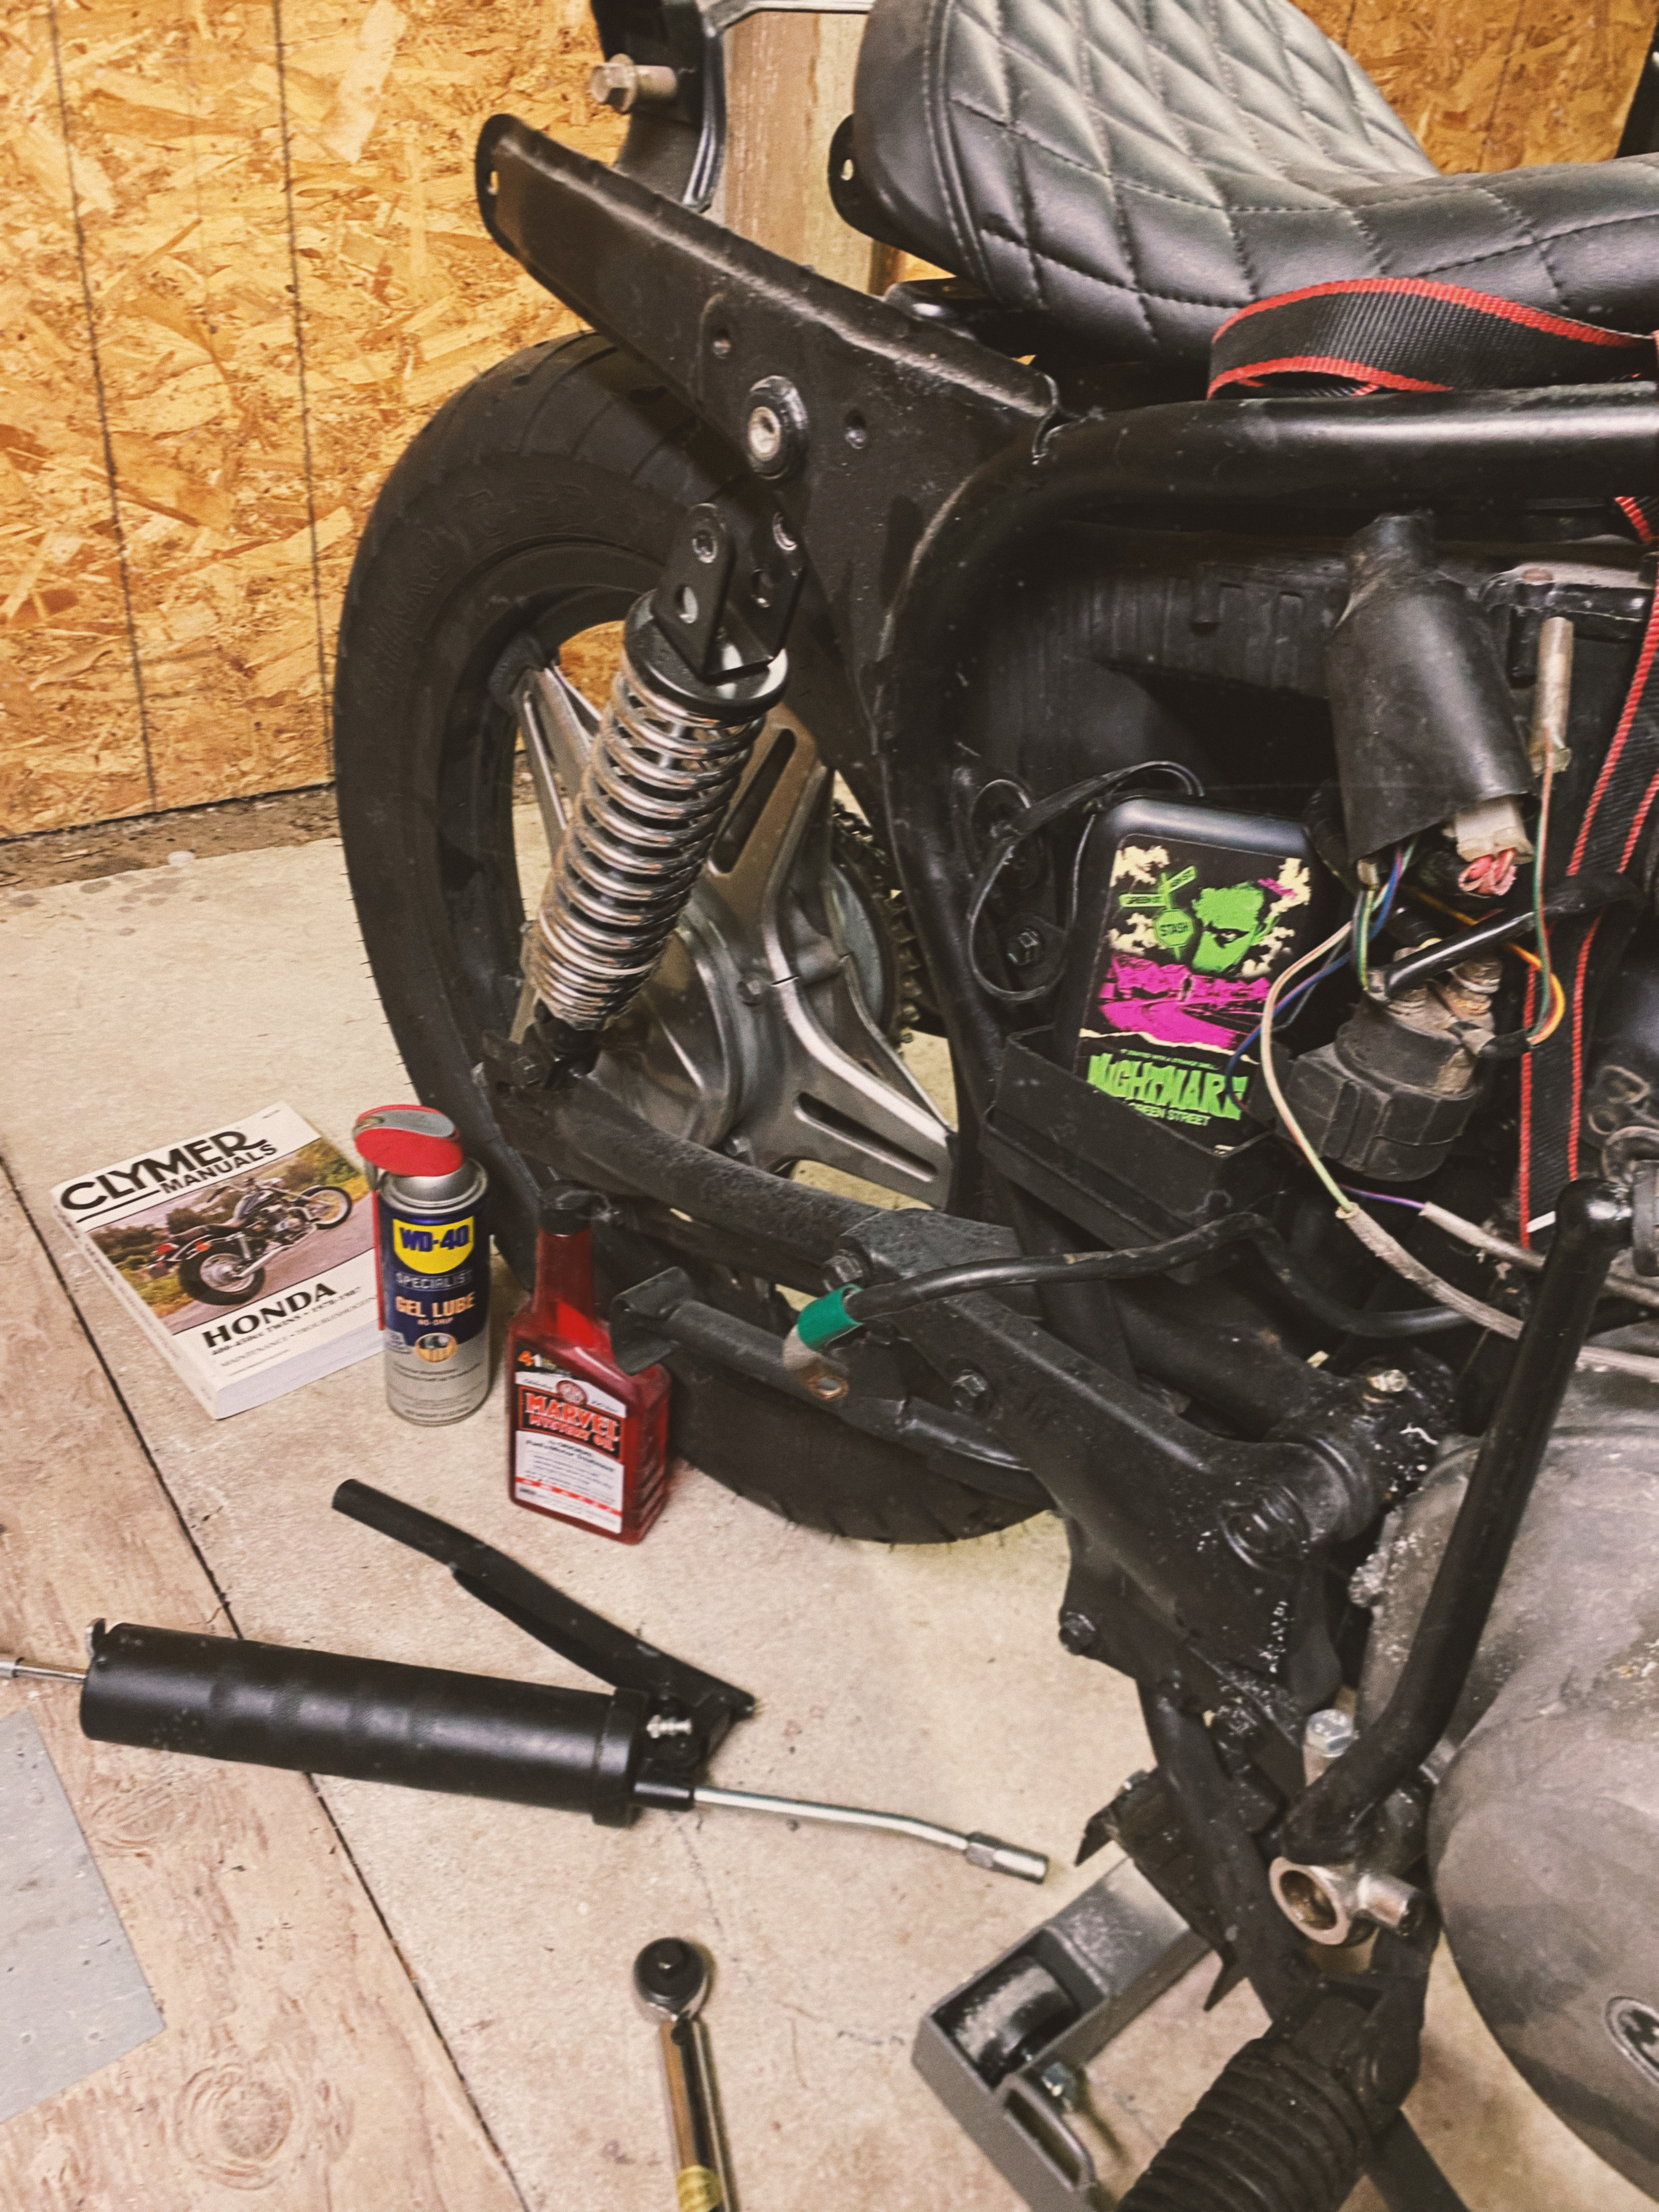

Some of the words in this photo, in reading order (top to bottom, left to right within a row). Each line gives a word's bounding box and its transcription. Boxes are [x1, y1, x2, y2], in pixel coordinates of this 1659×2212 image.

[1159, 921, 1189, 937] STASH
[1166, 1109, 1212, 1126] STREET
[60, 1130, 267, 1210] CLYMER
[160, 1144, 278, 1194] MANUALS
[399, 1224, 469, 1253] WD-40
[395, 1271, 472, 1289] SPECIALIST
[202, 1283, 337, 1348] HONDA
[395, 1296, 426, 1318] GEL
[431, 1292, 475, 1318] LUBE
[524, 1392, 620, 1442] MARVEL
